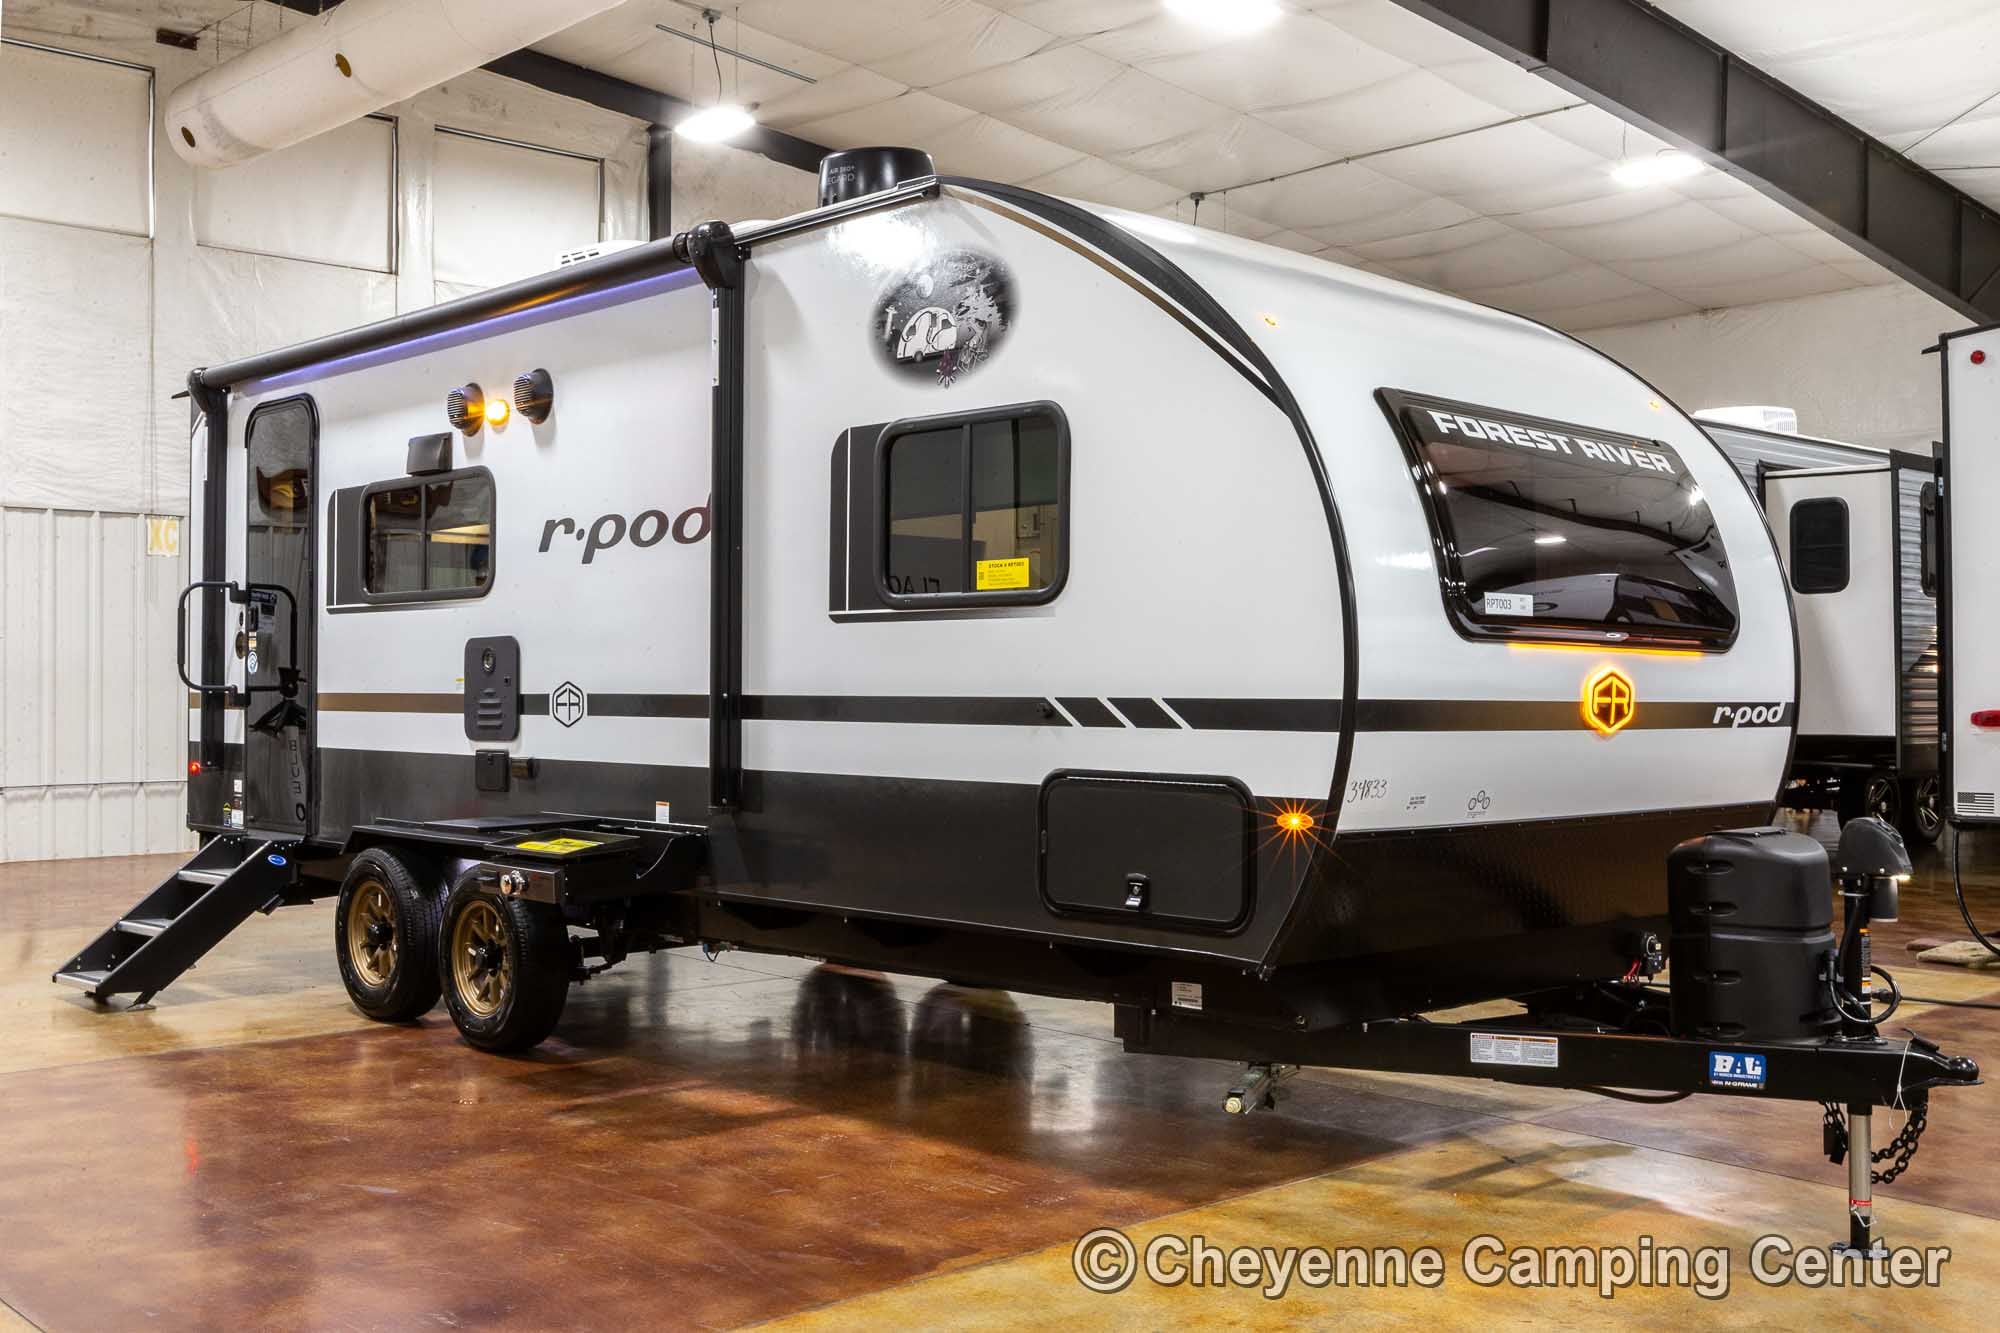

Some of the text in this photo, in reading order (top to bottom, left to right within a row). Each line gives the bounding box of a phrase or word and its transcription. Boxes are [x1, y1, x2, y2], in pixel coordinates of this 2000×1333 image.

[1427, 410, 1676, 474] FOREST RIVER
[1486, 598, 1512, 610] RPT003
[1347, 779, 1388, 803] 34833
[1714, 1054, 1762, 1075] BAL
